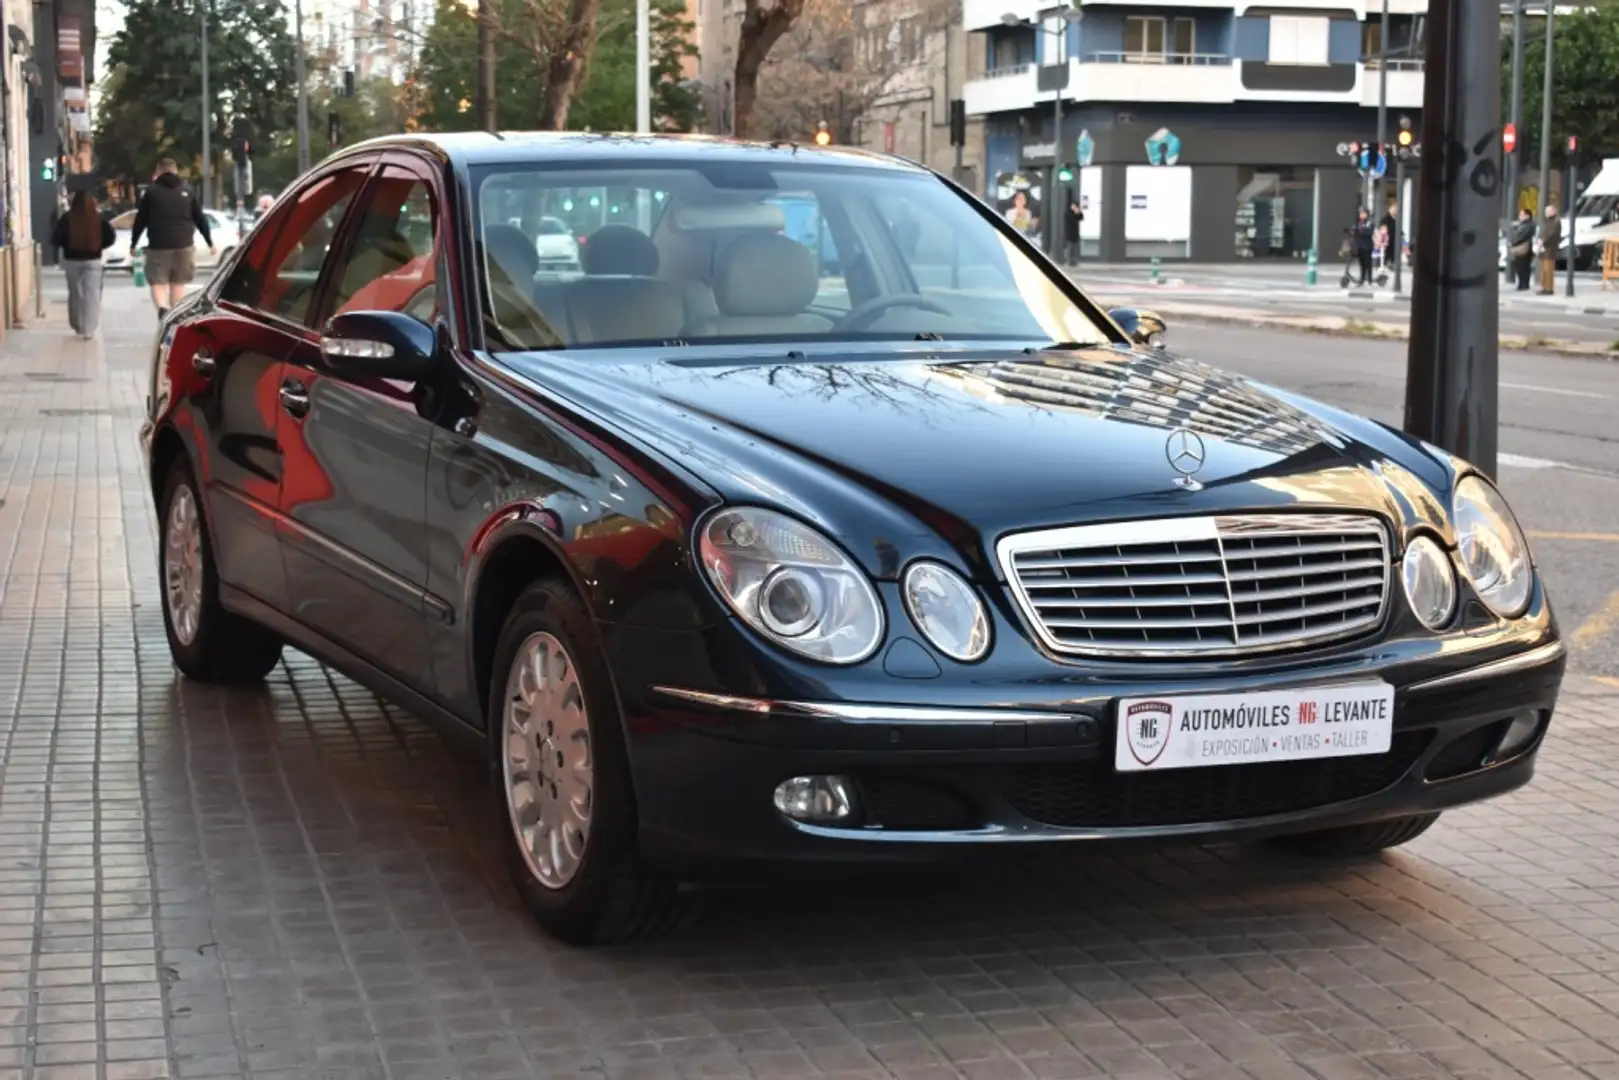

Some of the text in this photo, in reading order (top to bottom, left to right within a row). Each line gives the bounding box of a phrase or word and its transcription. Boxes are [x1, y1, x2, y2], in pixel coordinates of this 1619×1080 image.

[1180, 699, 1387, 731] AUTOMÓVILES NG LEVANTE
[1140, 718, 1158, 739] NG
[1202, 731, 1368, 757] EXPOSICIÓN VENTAS TALLER
